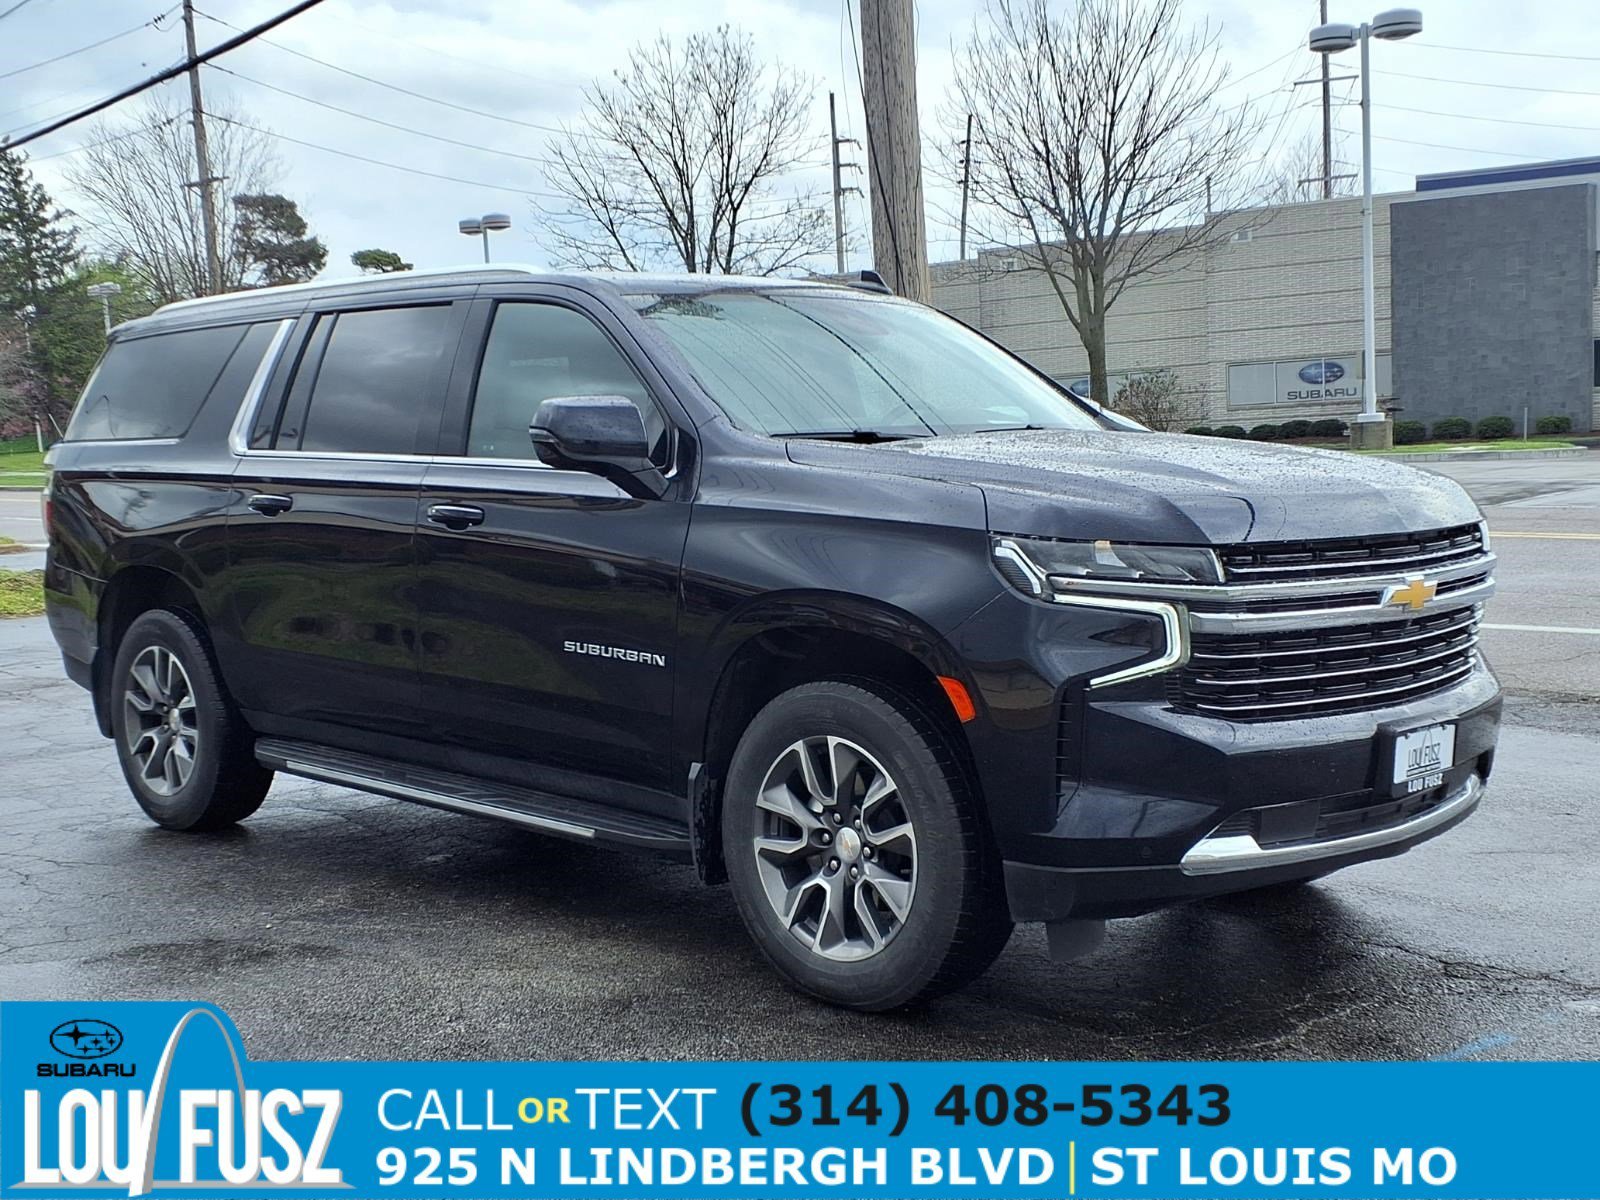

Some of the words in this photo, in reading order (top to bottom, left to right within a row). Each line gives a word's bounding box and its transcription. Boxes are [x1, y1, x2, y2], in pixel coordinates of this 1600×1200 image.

[1287, 388, 1357, 400] SUBARU
[563, 640, 666, 667] SUBURBAN
[1408, 747, 1421, 768] LOU
[1424, 743, 1440, 764] FUSZ
[1408, 777, 1424, 793] LOU
[1424, 773, 1443, 789] FUSZ
